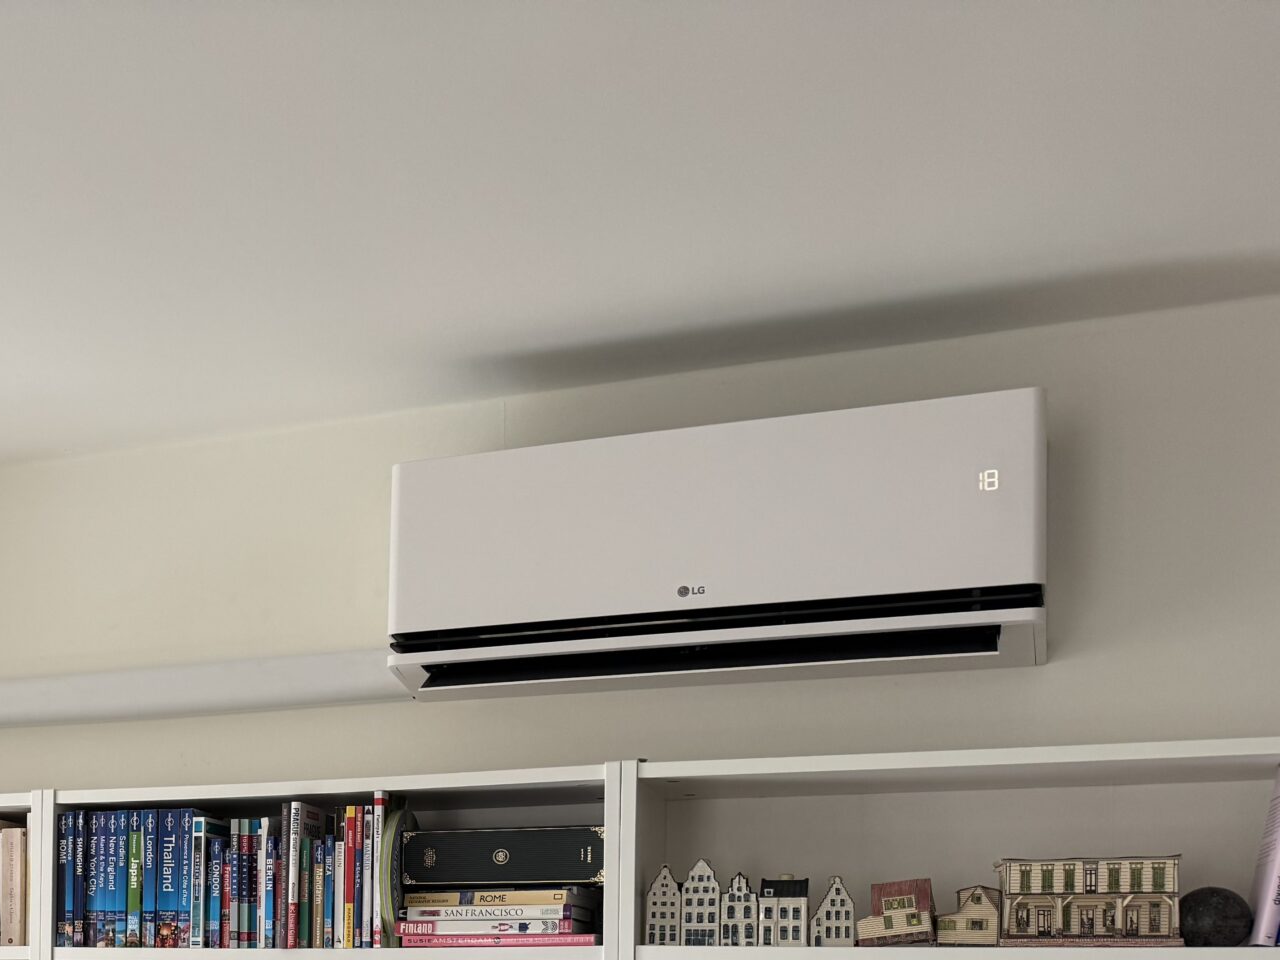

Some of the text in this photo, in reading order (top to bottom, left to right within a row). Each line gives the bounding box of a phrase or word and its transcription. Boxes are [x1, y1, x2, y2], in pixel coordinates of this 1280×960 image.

[978, 469, 999, 492] 18
[690, 585, 706, 596] LG
[146, 835, 154, 868] London
[130, 857, 139, 889] Japan
[162, 834, 174, 892] Thailand
[88, 879, 96, 896] City
[479, 895, 507, 903] ROME
[444, 908, 523, 917] SAN FRANCISCO
